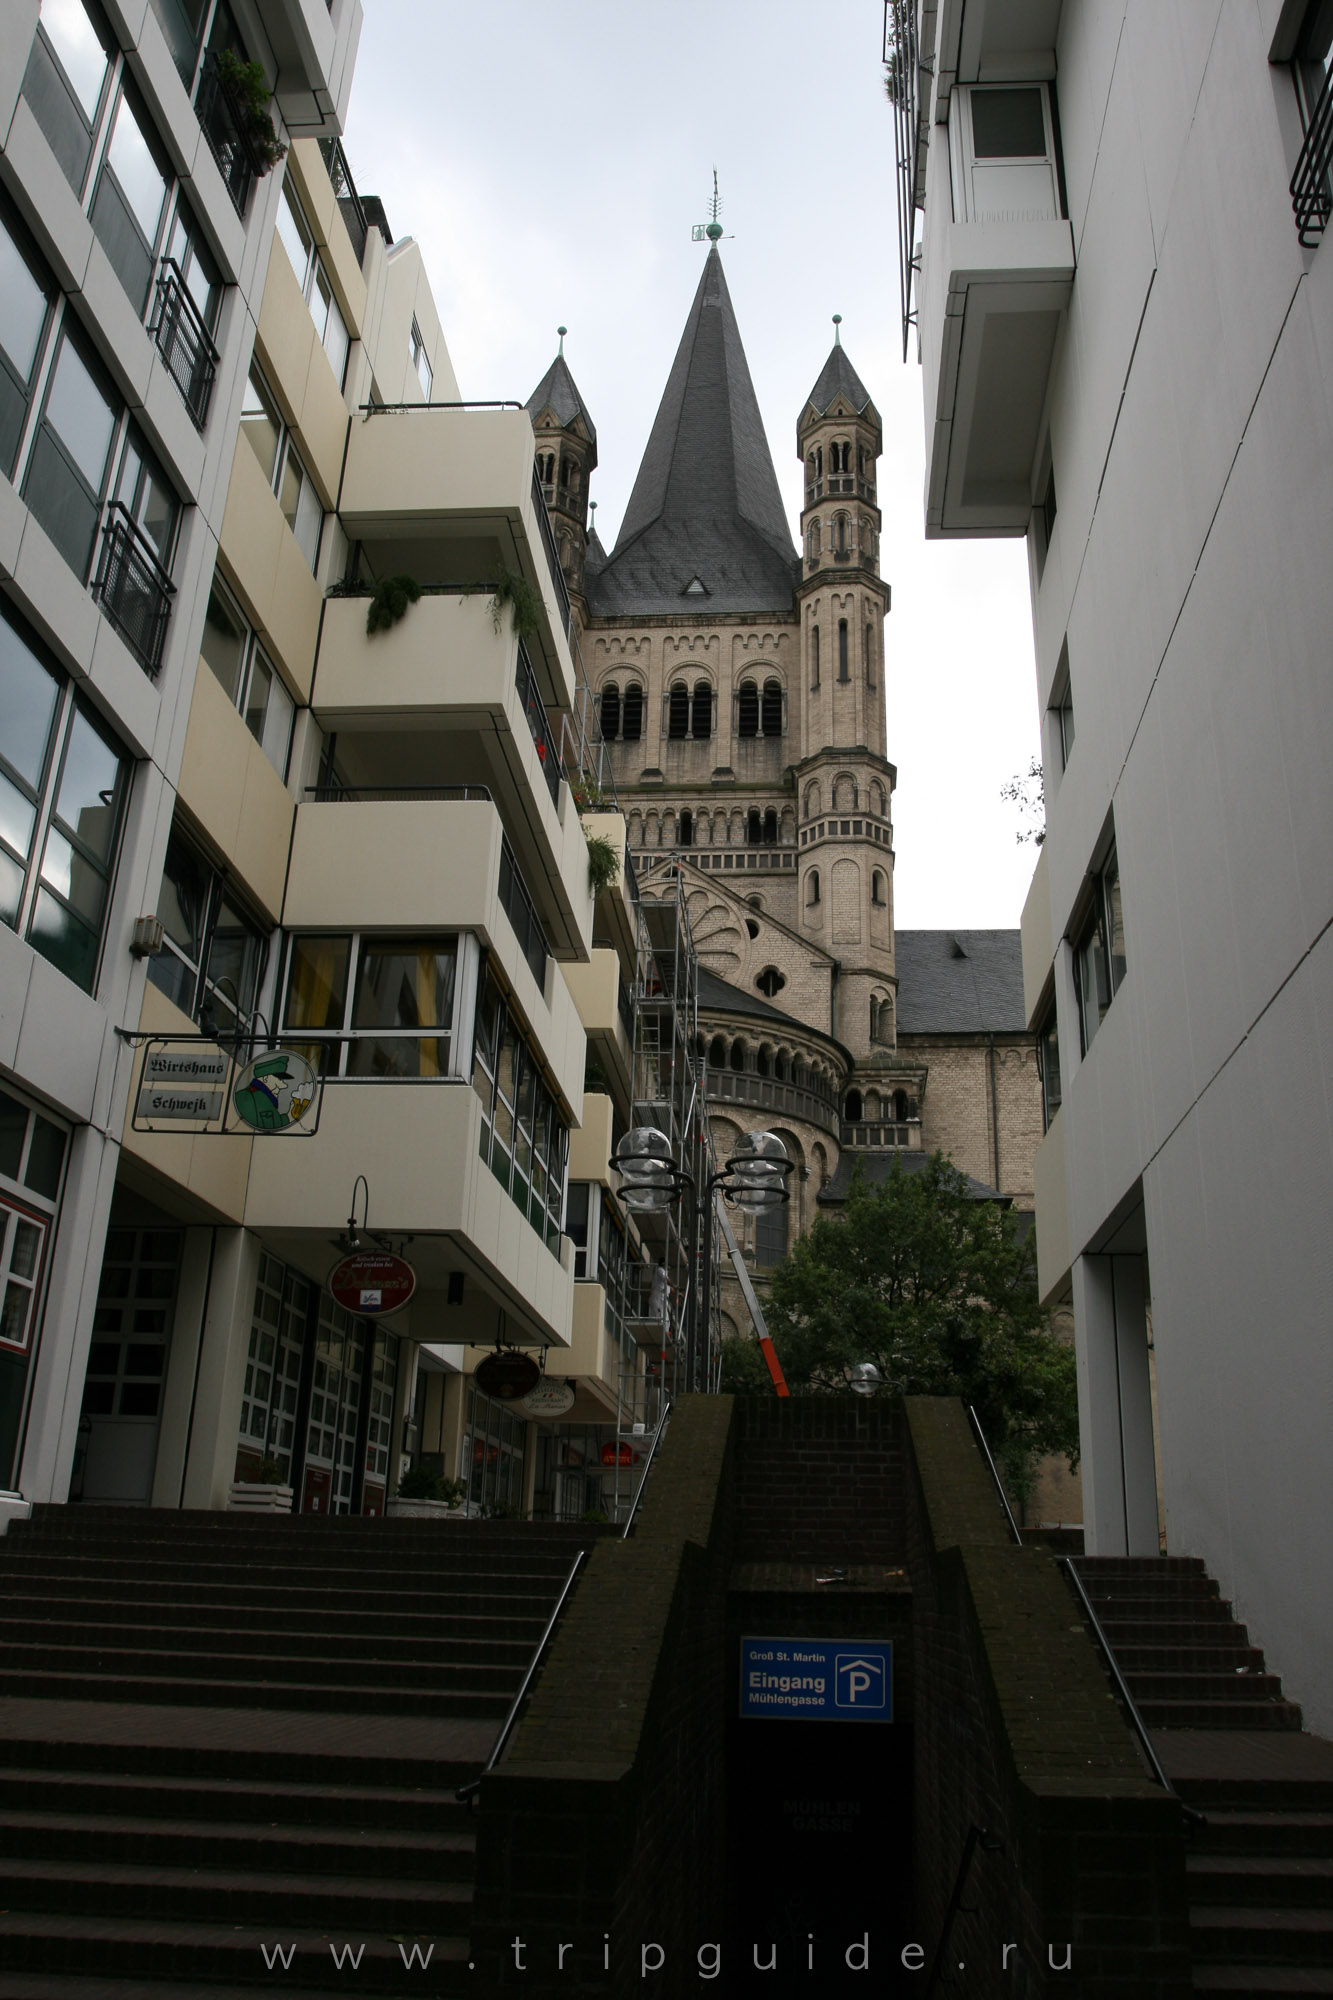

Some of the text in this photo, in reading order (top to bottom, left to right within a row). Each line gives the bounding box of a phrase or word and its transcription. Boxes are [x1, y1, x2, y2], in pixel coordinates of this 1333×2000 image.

[151, 1058, 224, 1076] Wirtshaus
[152, 1097, 206, 1114] Schwejk
[749, 1651, 826, 1664] Groß St. Martin
[749, 1671, 826, 1695] Eingang
[748, 1692, 826, 1707] Mühlengasse
